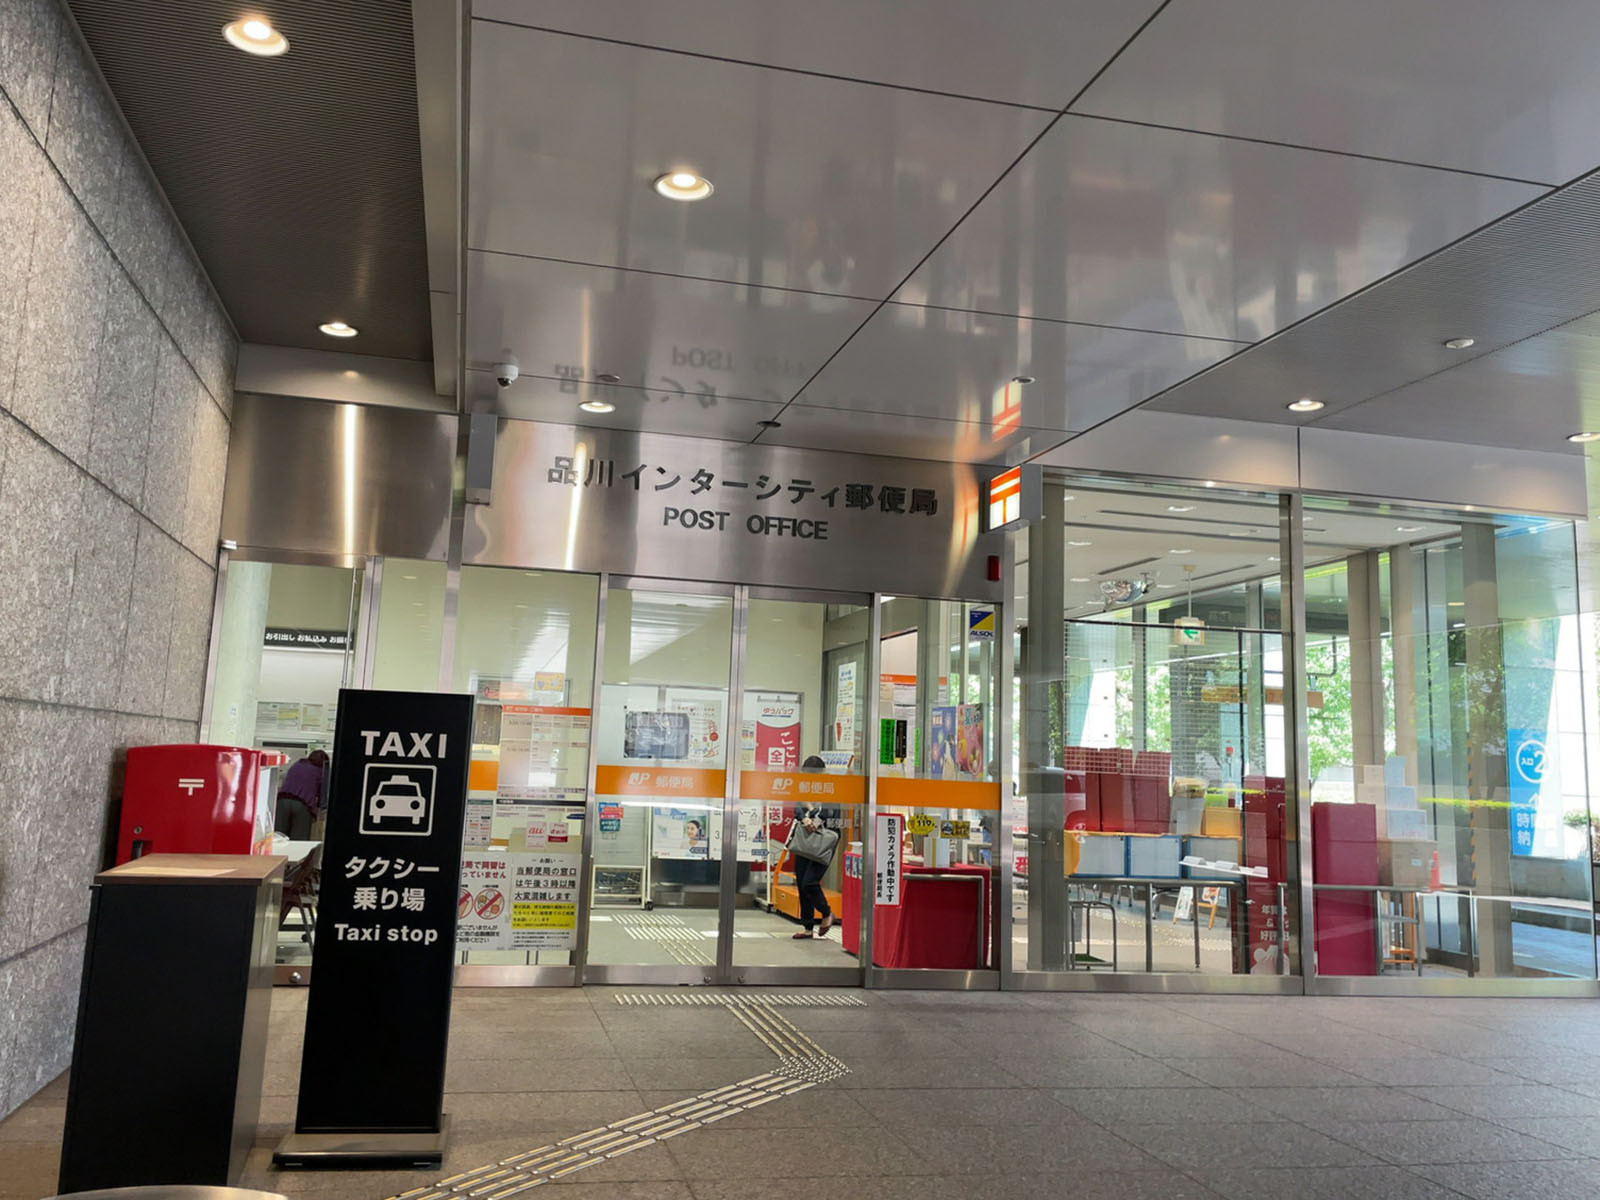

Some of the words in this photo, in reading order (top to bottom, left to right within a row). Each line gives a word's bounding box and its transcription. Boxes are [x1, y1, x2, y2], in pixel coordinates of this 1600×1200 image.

[547, 456, 938, 516] 品川インターシティ郵便局
[662, 506, 730, 531] POST
[746, 513, 829, 540] OFFICE
[360, 730, 448, 758] TAXI
[798, 782, 834, 795] 郵便局
[344, 857, 440, 879] タクシー
[516, 866, 577, 876] 当郵便局の窓口
[886, 818, 896, 902] 防犯カメラ作動中です
[352, 887, 426, 911] 乗り場
[514, 892, 571, 901] 大変混雑します
[334, 923, 381, 941] Taxi
[387, 924, 438, 946] stop
